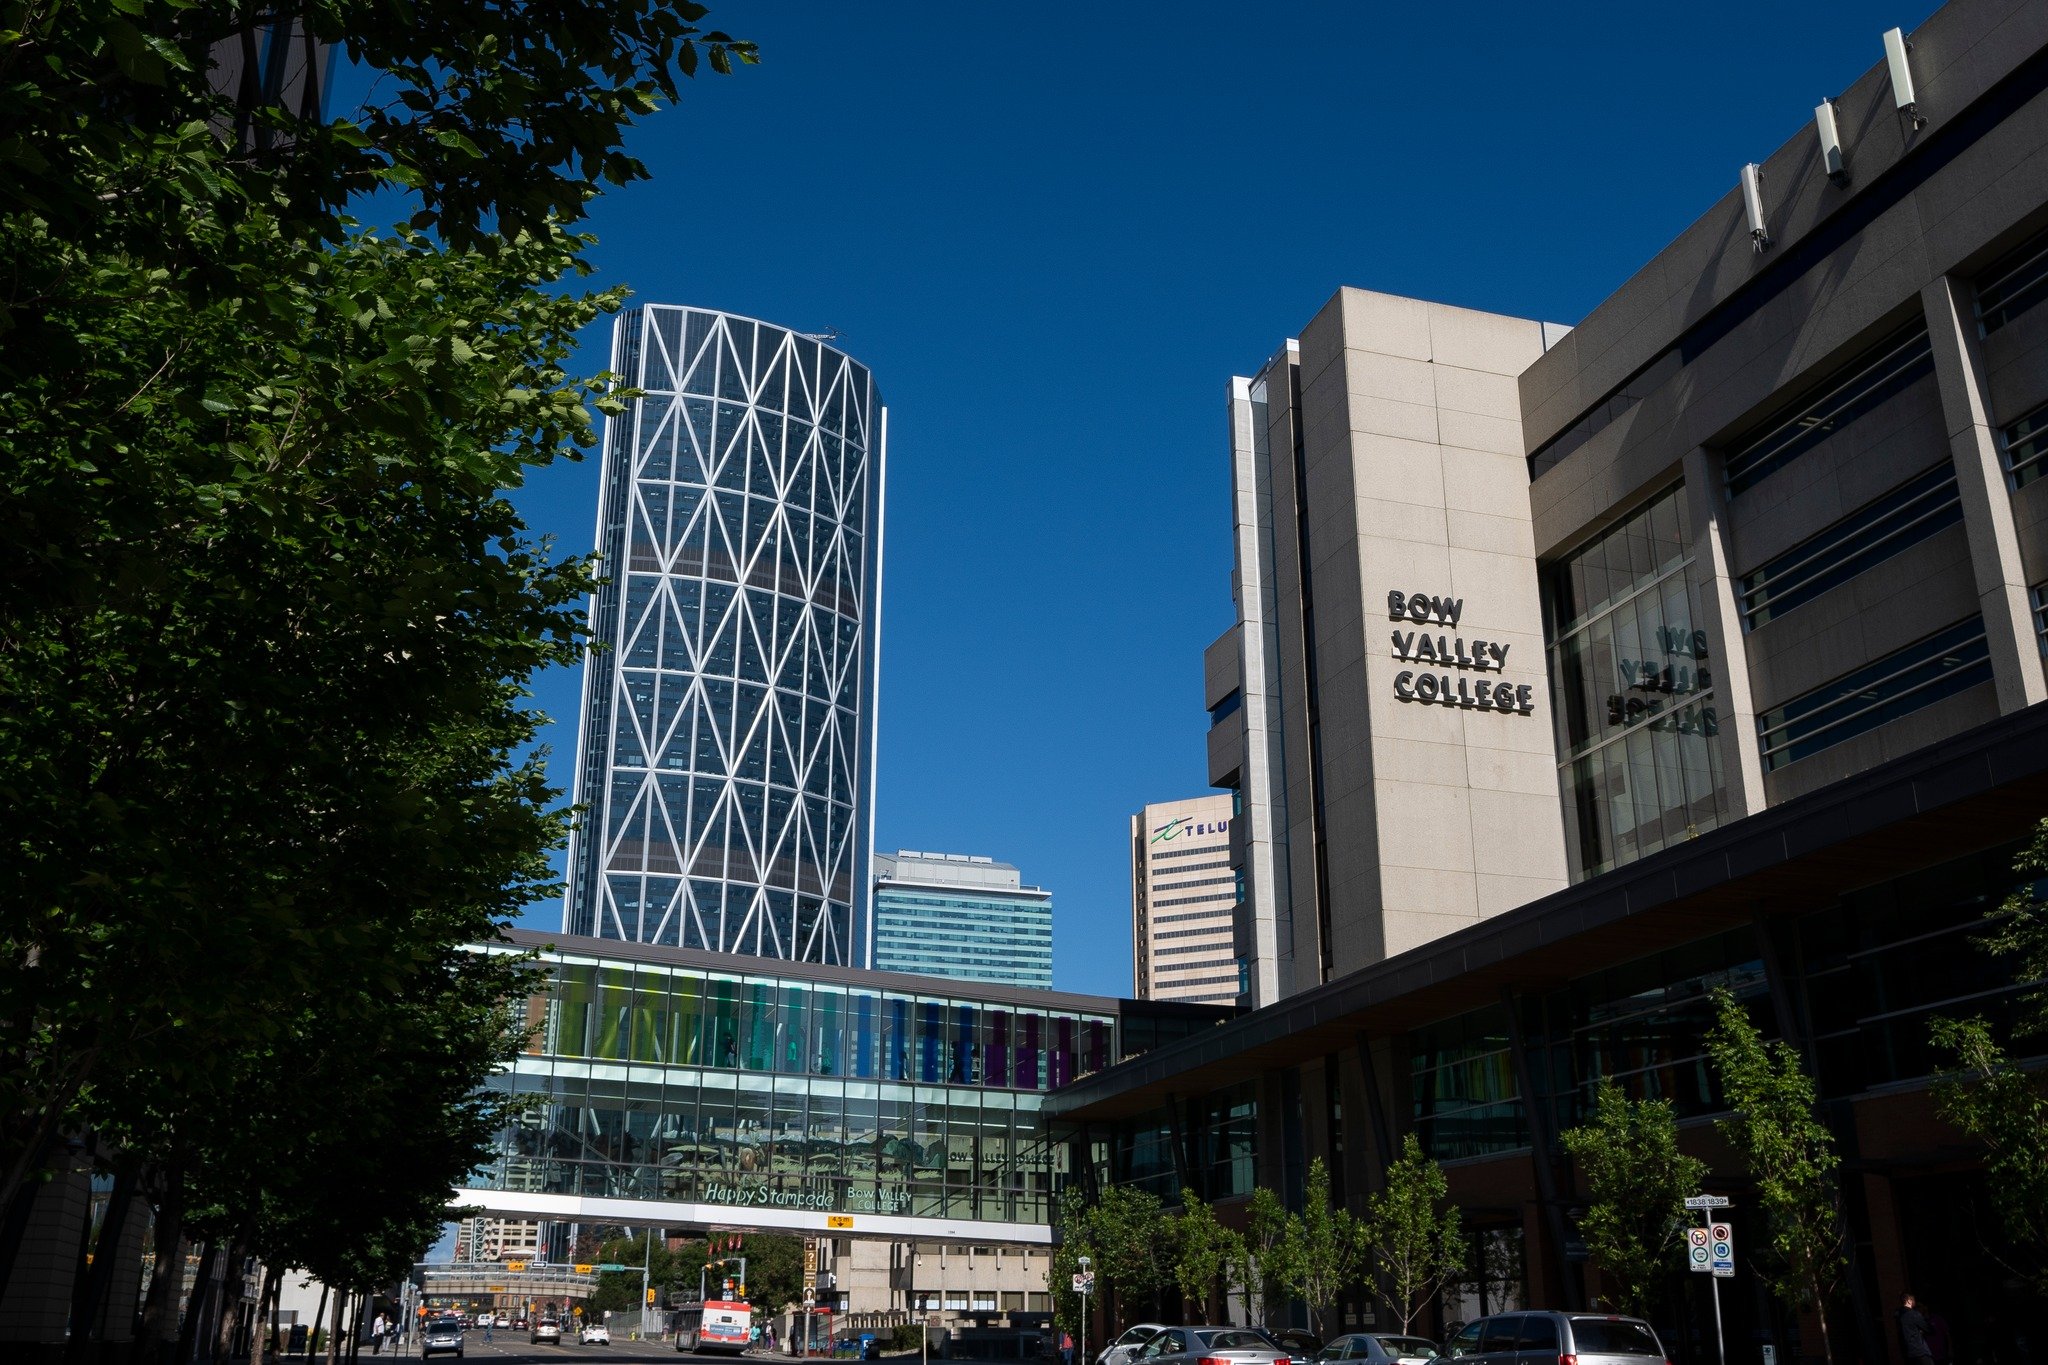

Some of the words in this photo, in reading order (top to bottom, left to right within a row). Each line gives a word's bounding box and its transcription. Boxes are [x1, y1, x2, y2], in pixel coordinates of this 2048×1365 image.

[1388, 590, 1463, 625] BOW
[1391, 630, 1510, 670] VALLEY
[1394, 671, 1534, 711] COLLEGE
[1185, 820, 1228, 837] TELU
[949, 1151, 968, 1163] OW
[705, 1182, 755, 1207] Happy
[757, 1185, 834, 1209] Stampede
[878, 1188, 912, 1203] VALLEY
[1690, 1198, 1706, 1206] 1838
[858, 1200, 899, 1212] COLLEGE
